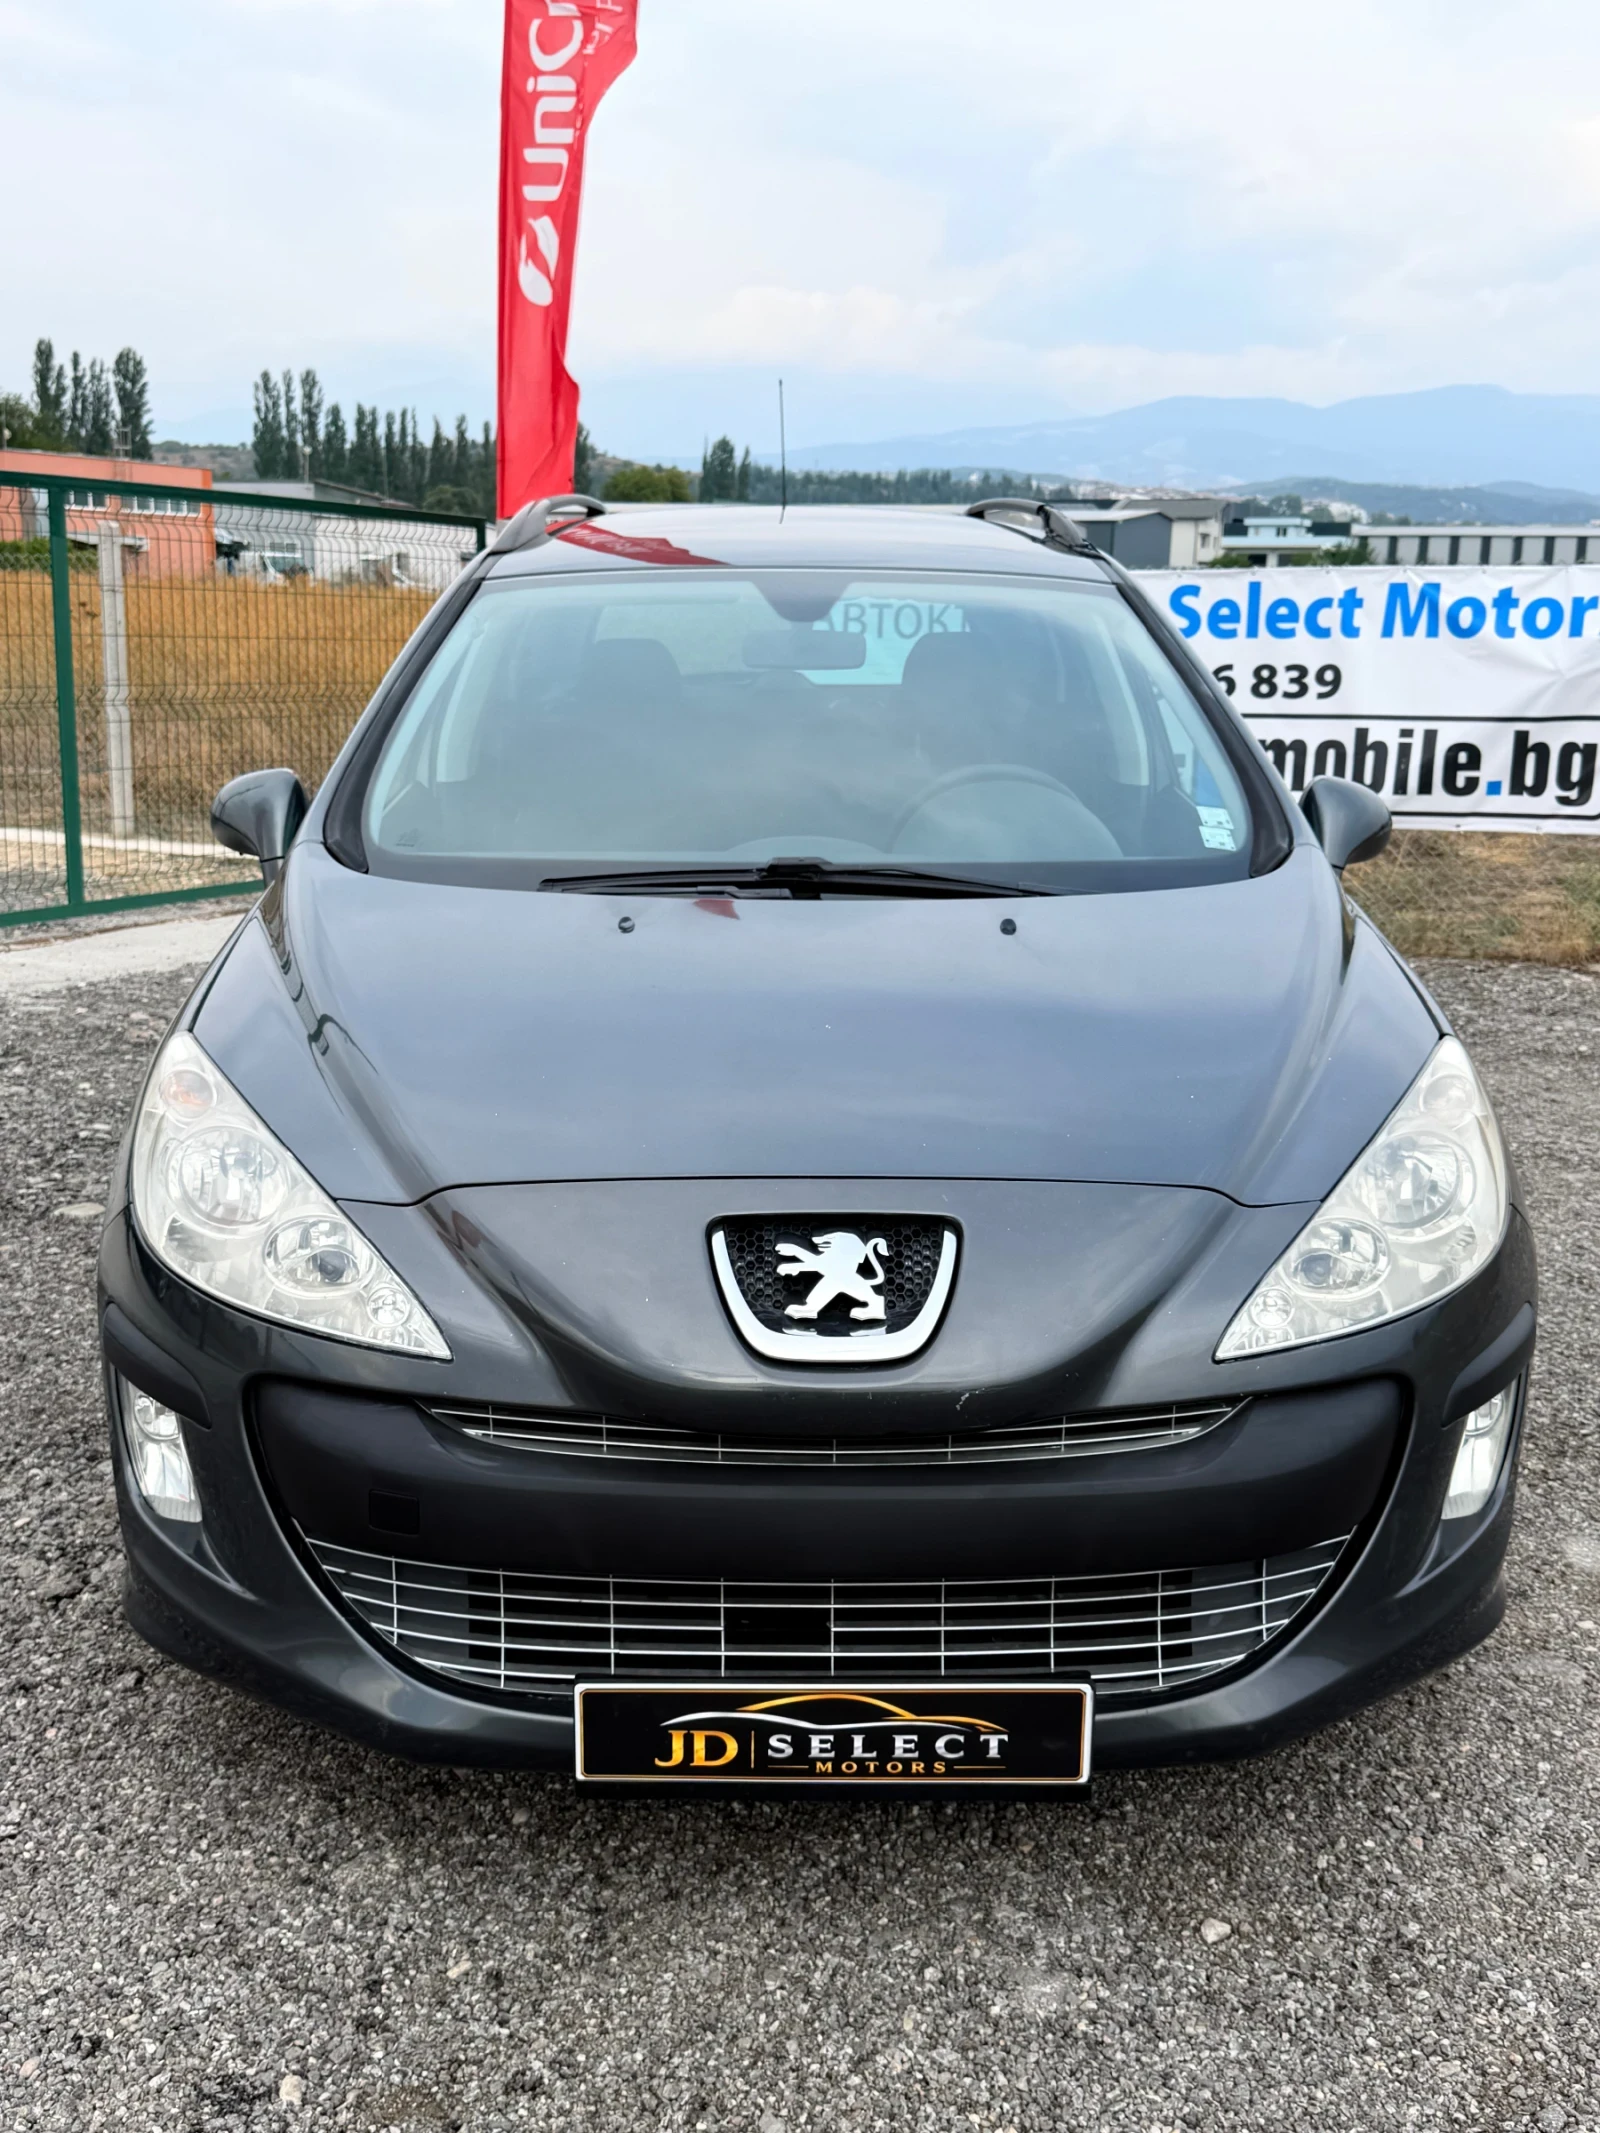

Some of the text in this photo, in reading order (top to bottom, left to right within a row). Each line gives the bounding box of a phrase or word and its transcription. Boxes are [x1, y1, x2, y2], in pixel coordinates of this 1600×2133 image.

[1169, 581, 1600, 640] Select Motor
[1250, 663, 1342, 700] 839
[1257, 727, 1598, 808] mobile.bg
[654, 1730, 1009, 1767] JD SELECT
[815, 1760, 947, 1774] MOTORS
